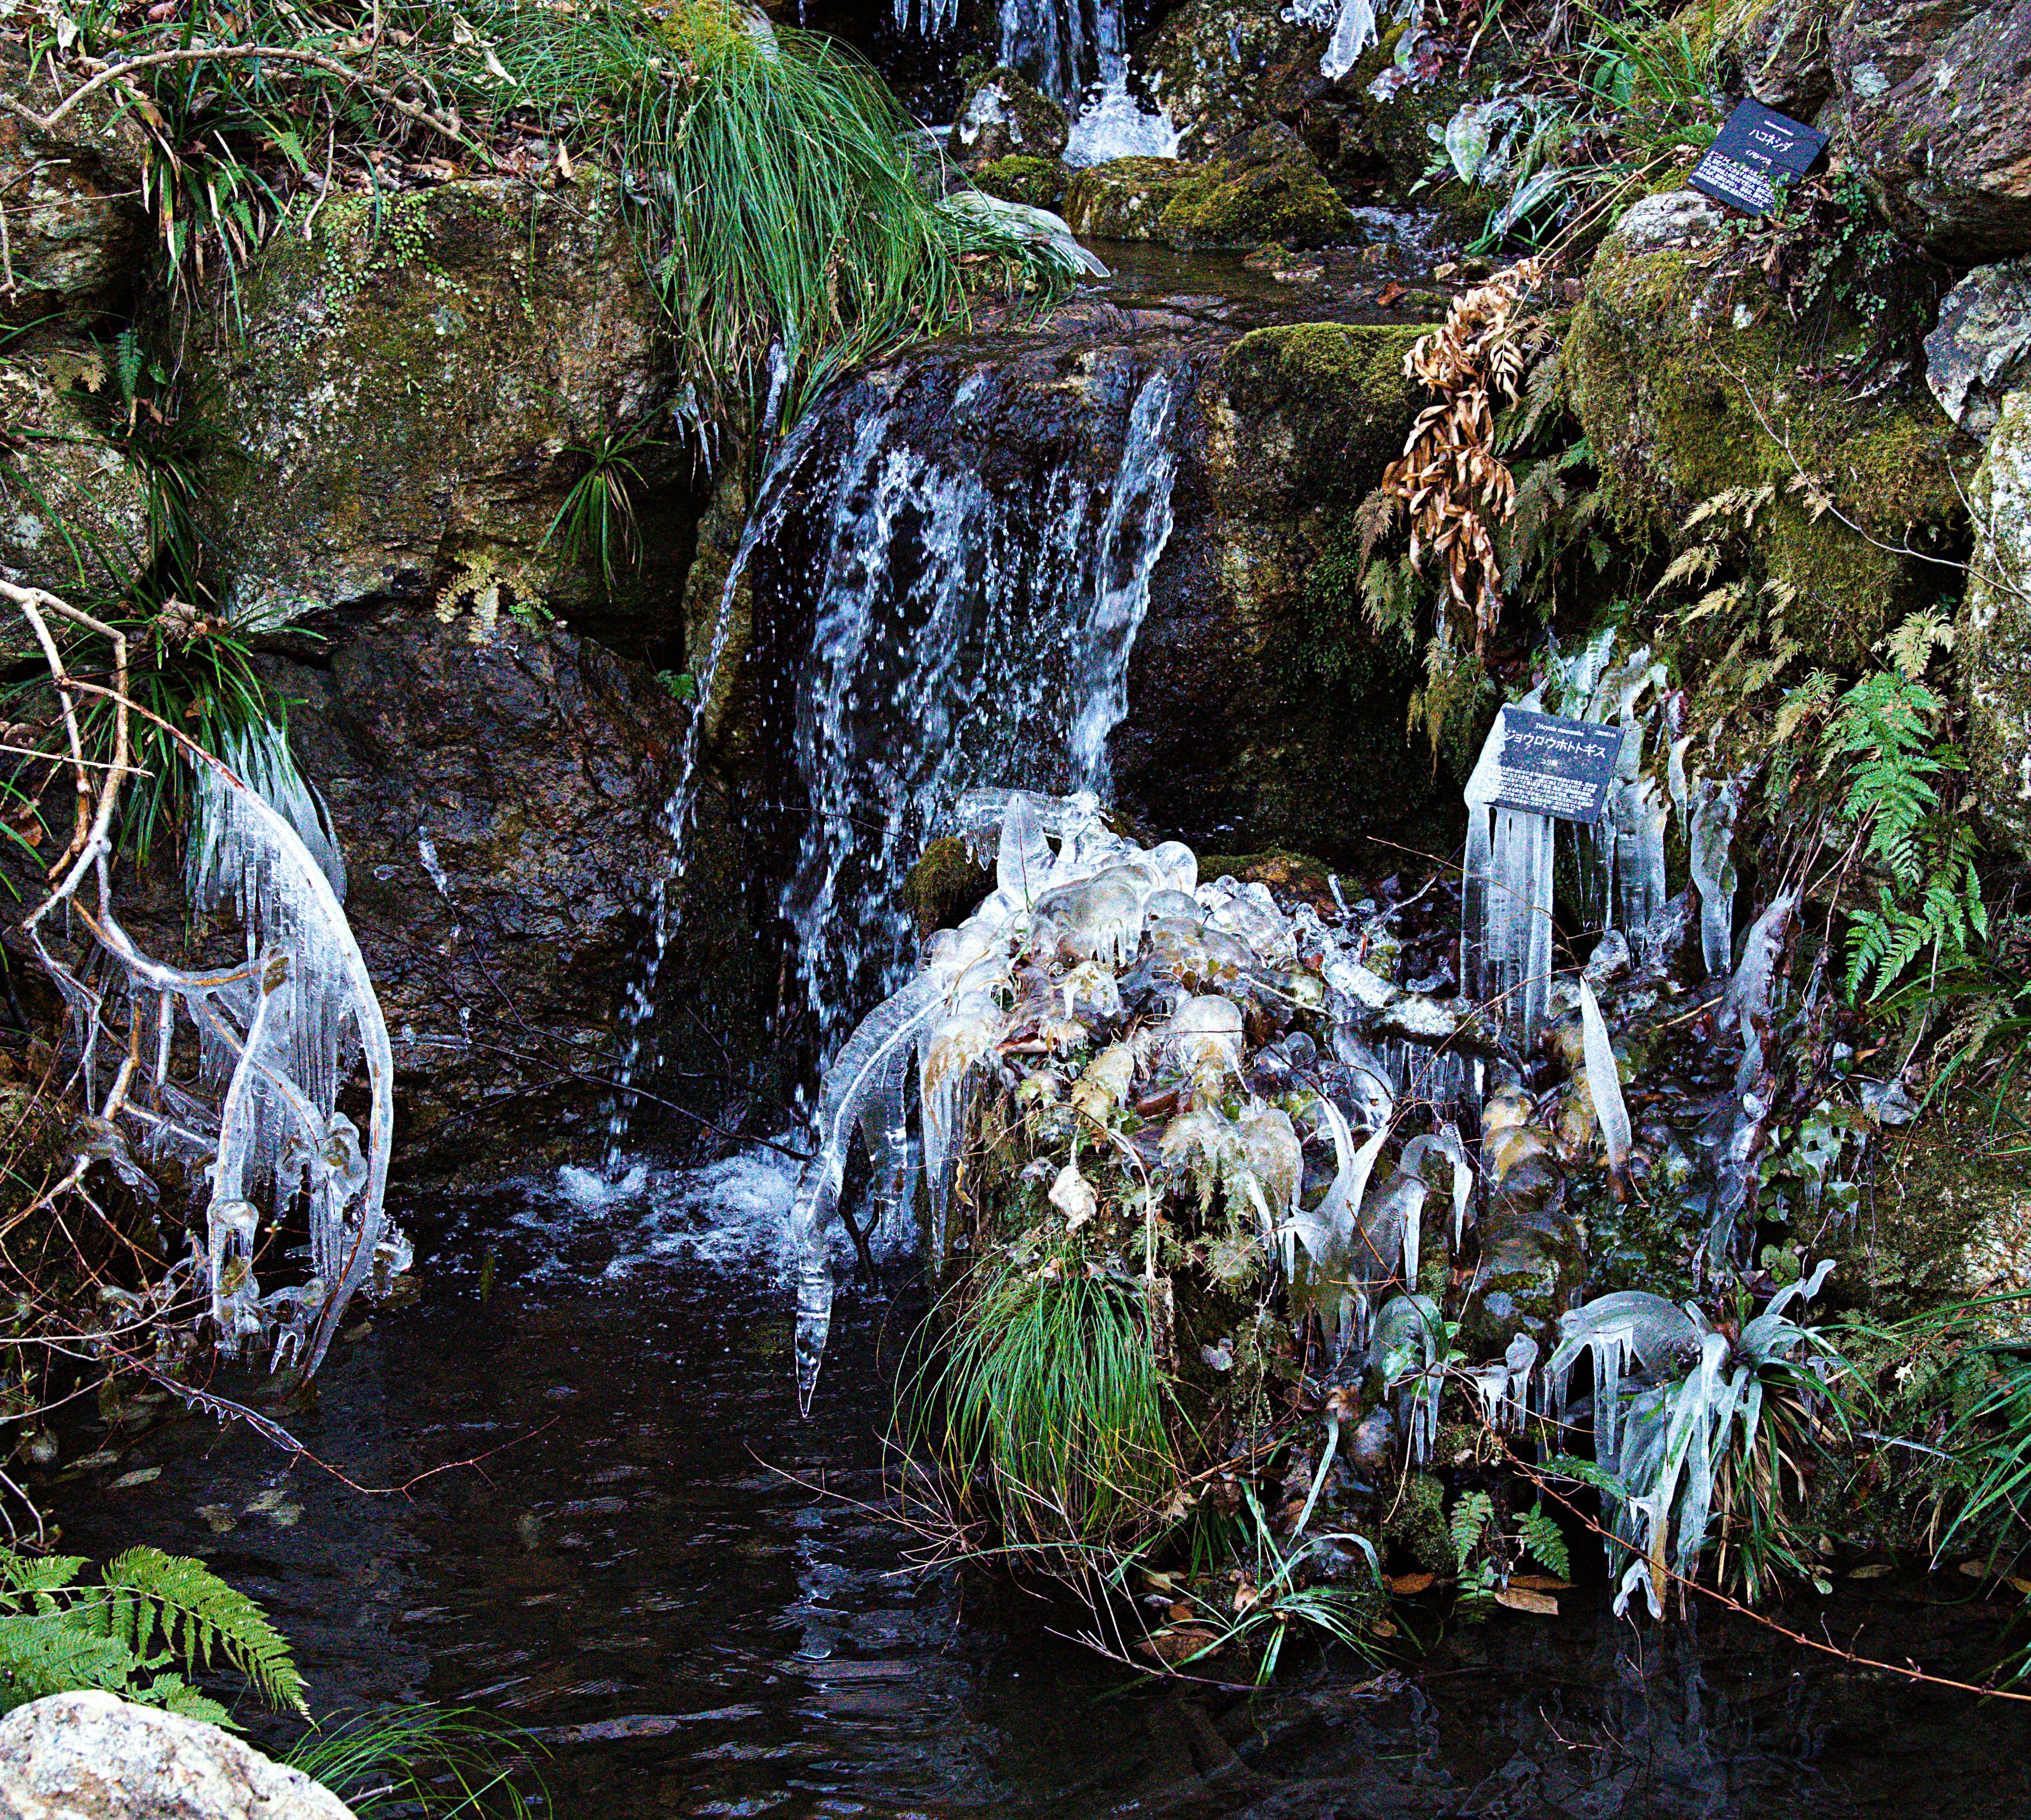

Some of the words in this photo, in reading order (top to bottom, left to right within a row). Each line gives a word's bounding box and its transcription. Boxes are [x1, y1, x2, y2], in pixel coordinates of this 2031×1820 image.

[1749, 128, 1794, 152] ハコネシダ
[1504, 729, 1606, 758] ジョウロウホトトギス
